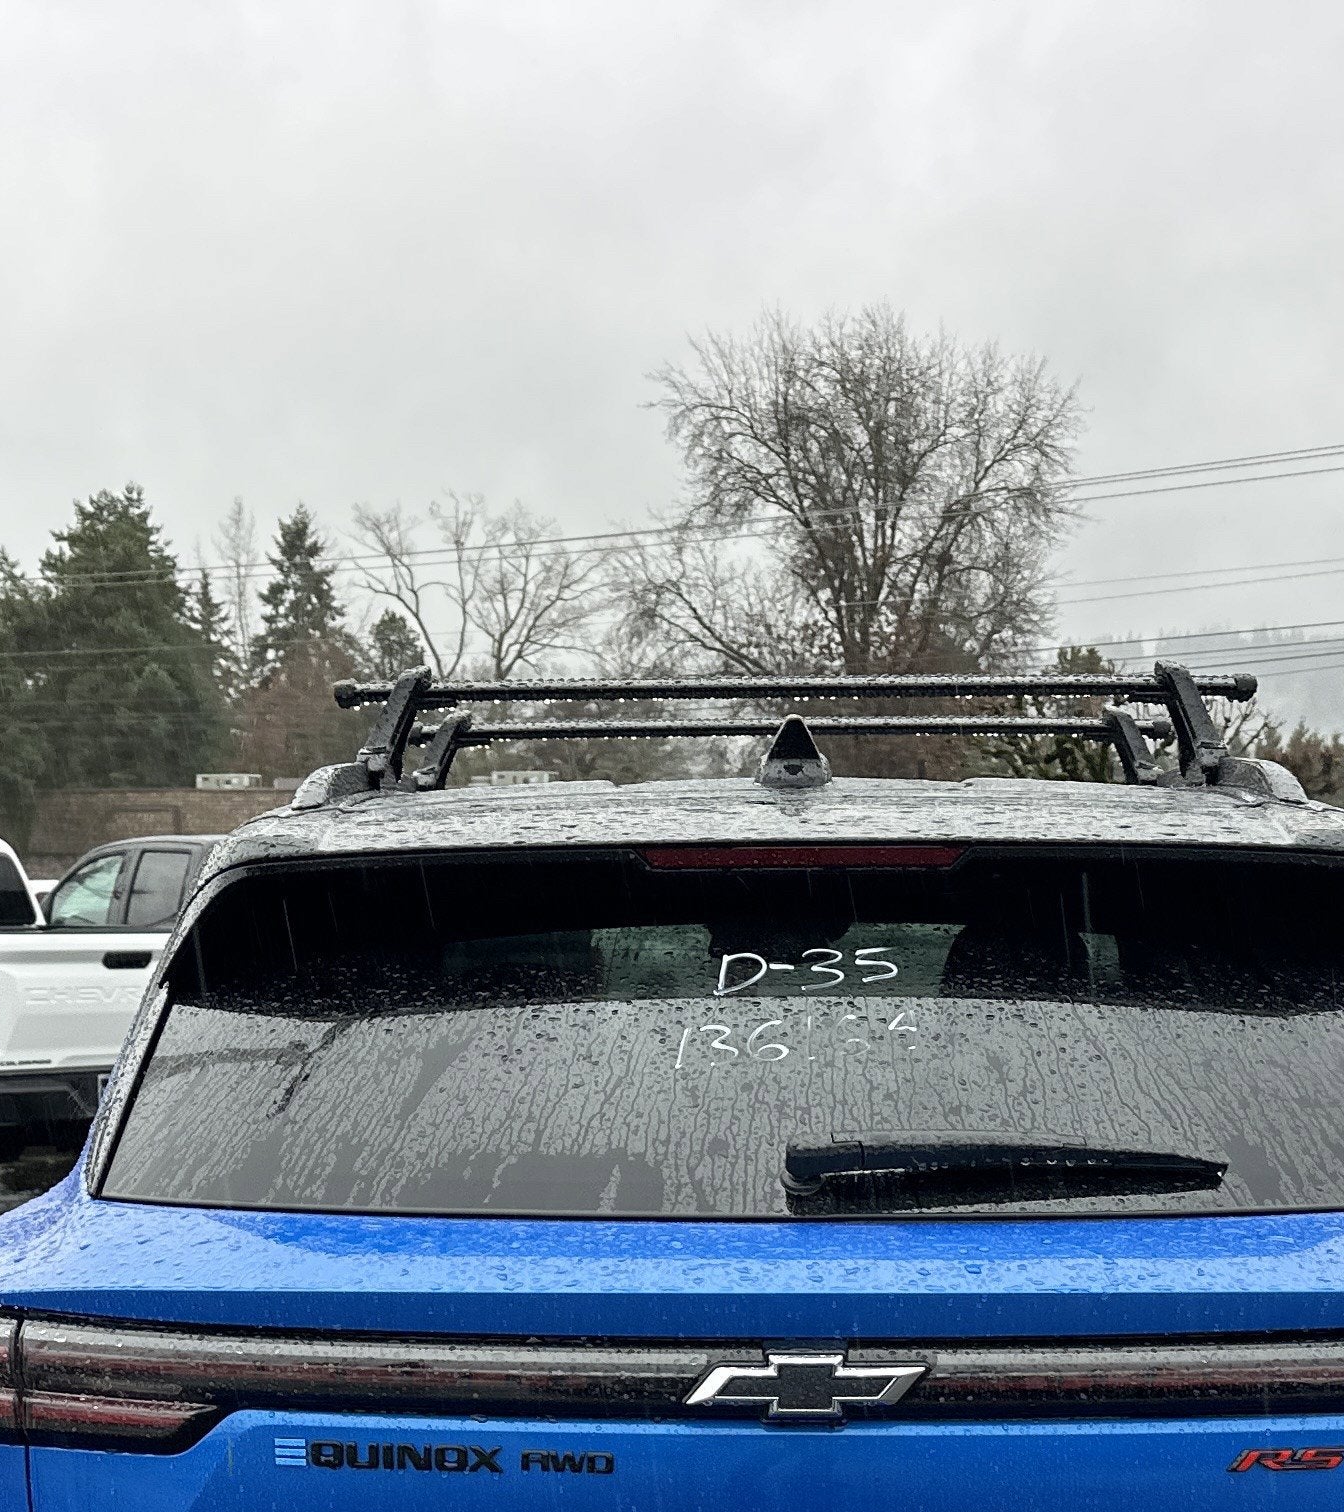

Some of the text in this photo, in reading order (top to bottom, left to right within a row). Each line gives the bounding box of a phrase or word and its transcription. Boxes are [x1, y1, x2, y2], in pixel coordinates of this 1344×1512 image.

[713, 948, 899, 995] D-35
[274, 1437, 616, 1475] EQUINOX AWD
